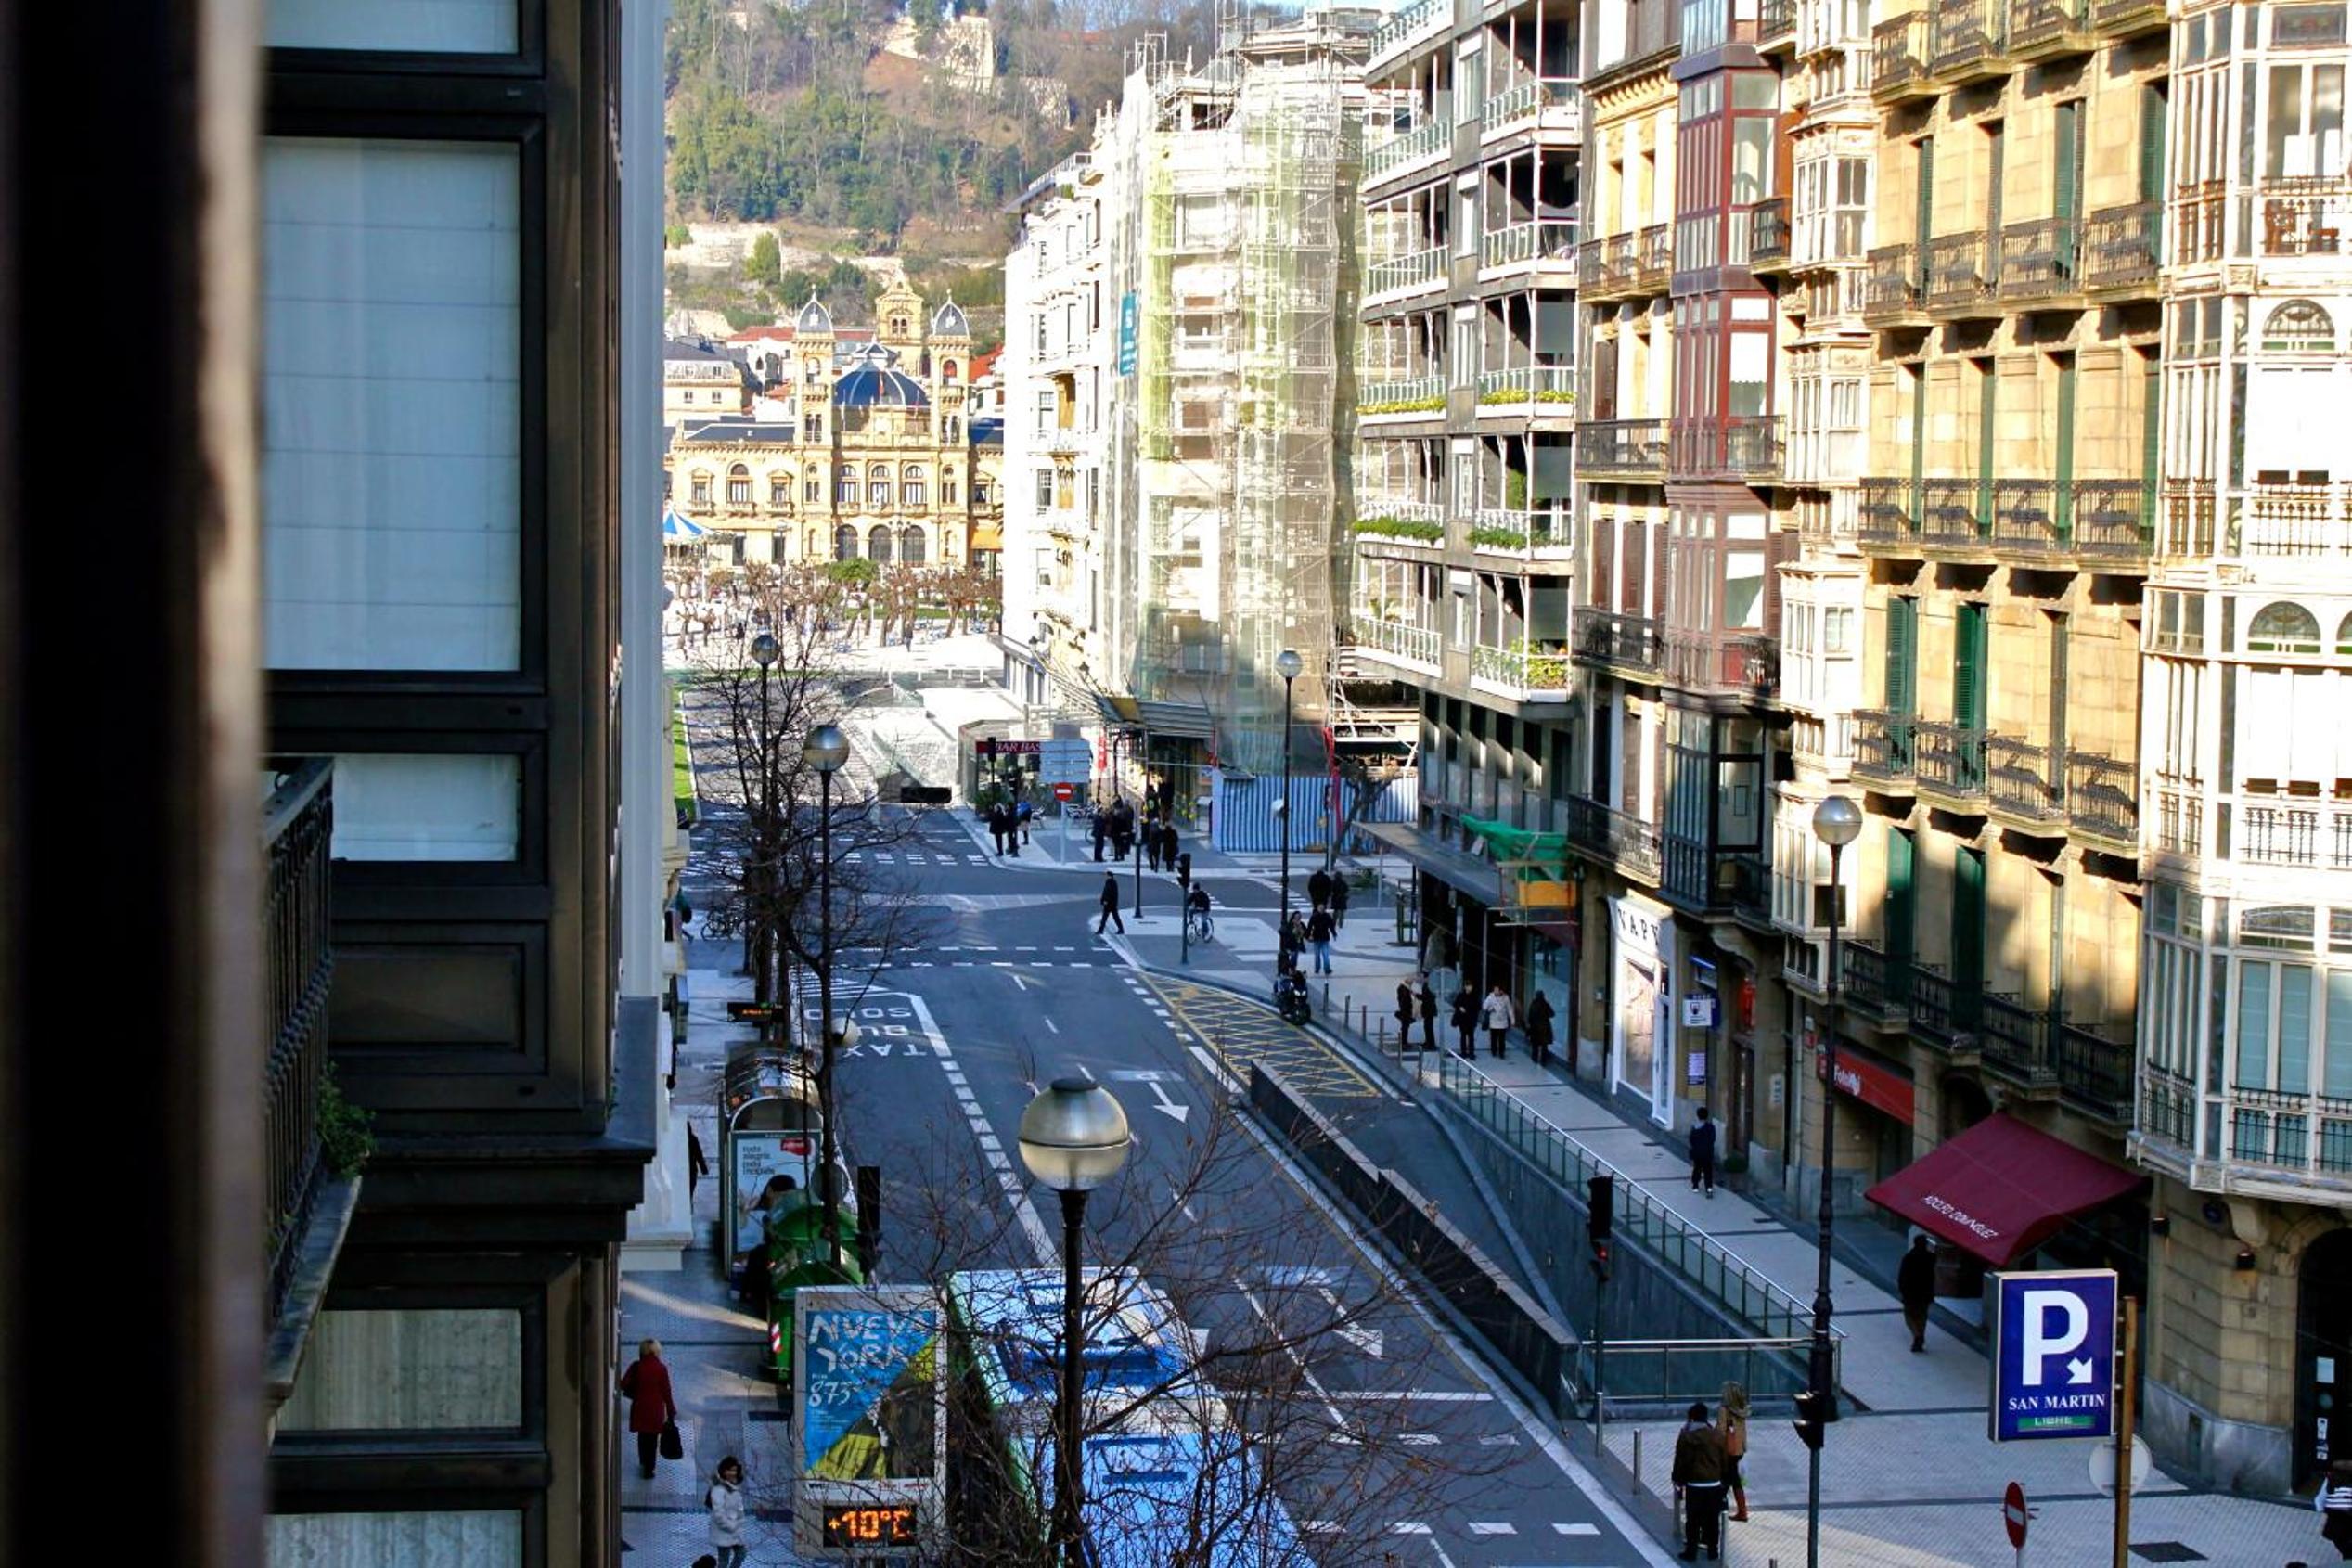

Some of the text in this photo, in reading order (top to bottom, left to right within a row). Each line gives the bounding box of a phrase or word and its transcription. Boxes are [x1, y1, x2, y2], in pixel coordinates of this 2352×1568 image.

[859, 1024, 909, 1036] BU
[842, 1044, 928, 1057] TAX
[2022, 1290, 2089, 1386] P
[2009, 1394, 2106, 1411] SAN MARTIN
